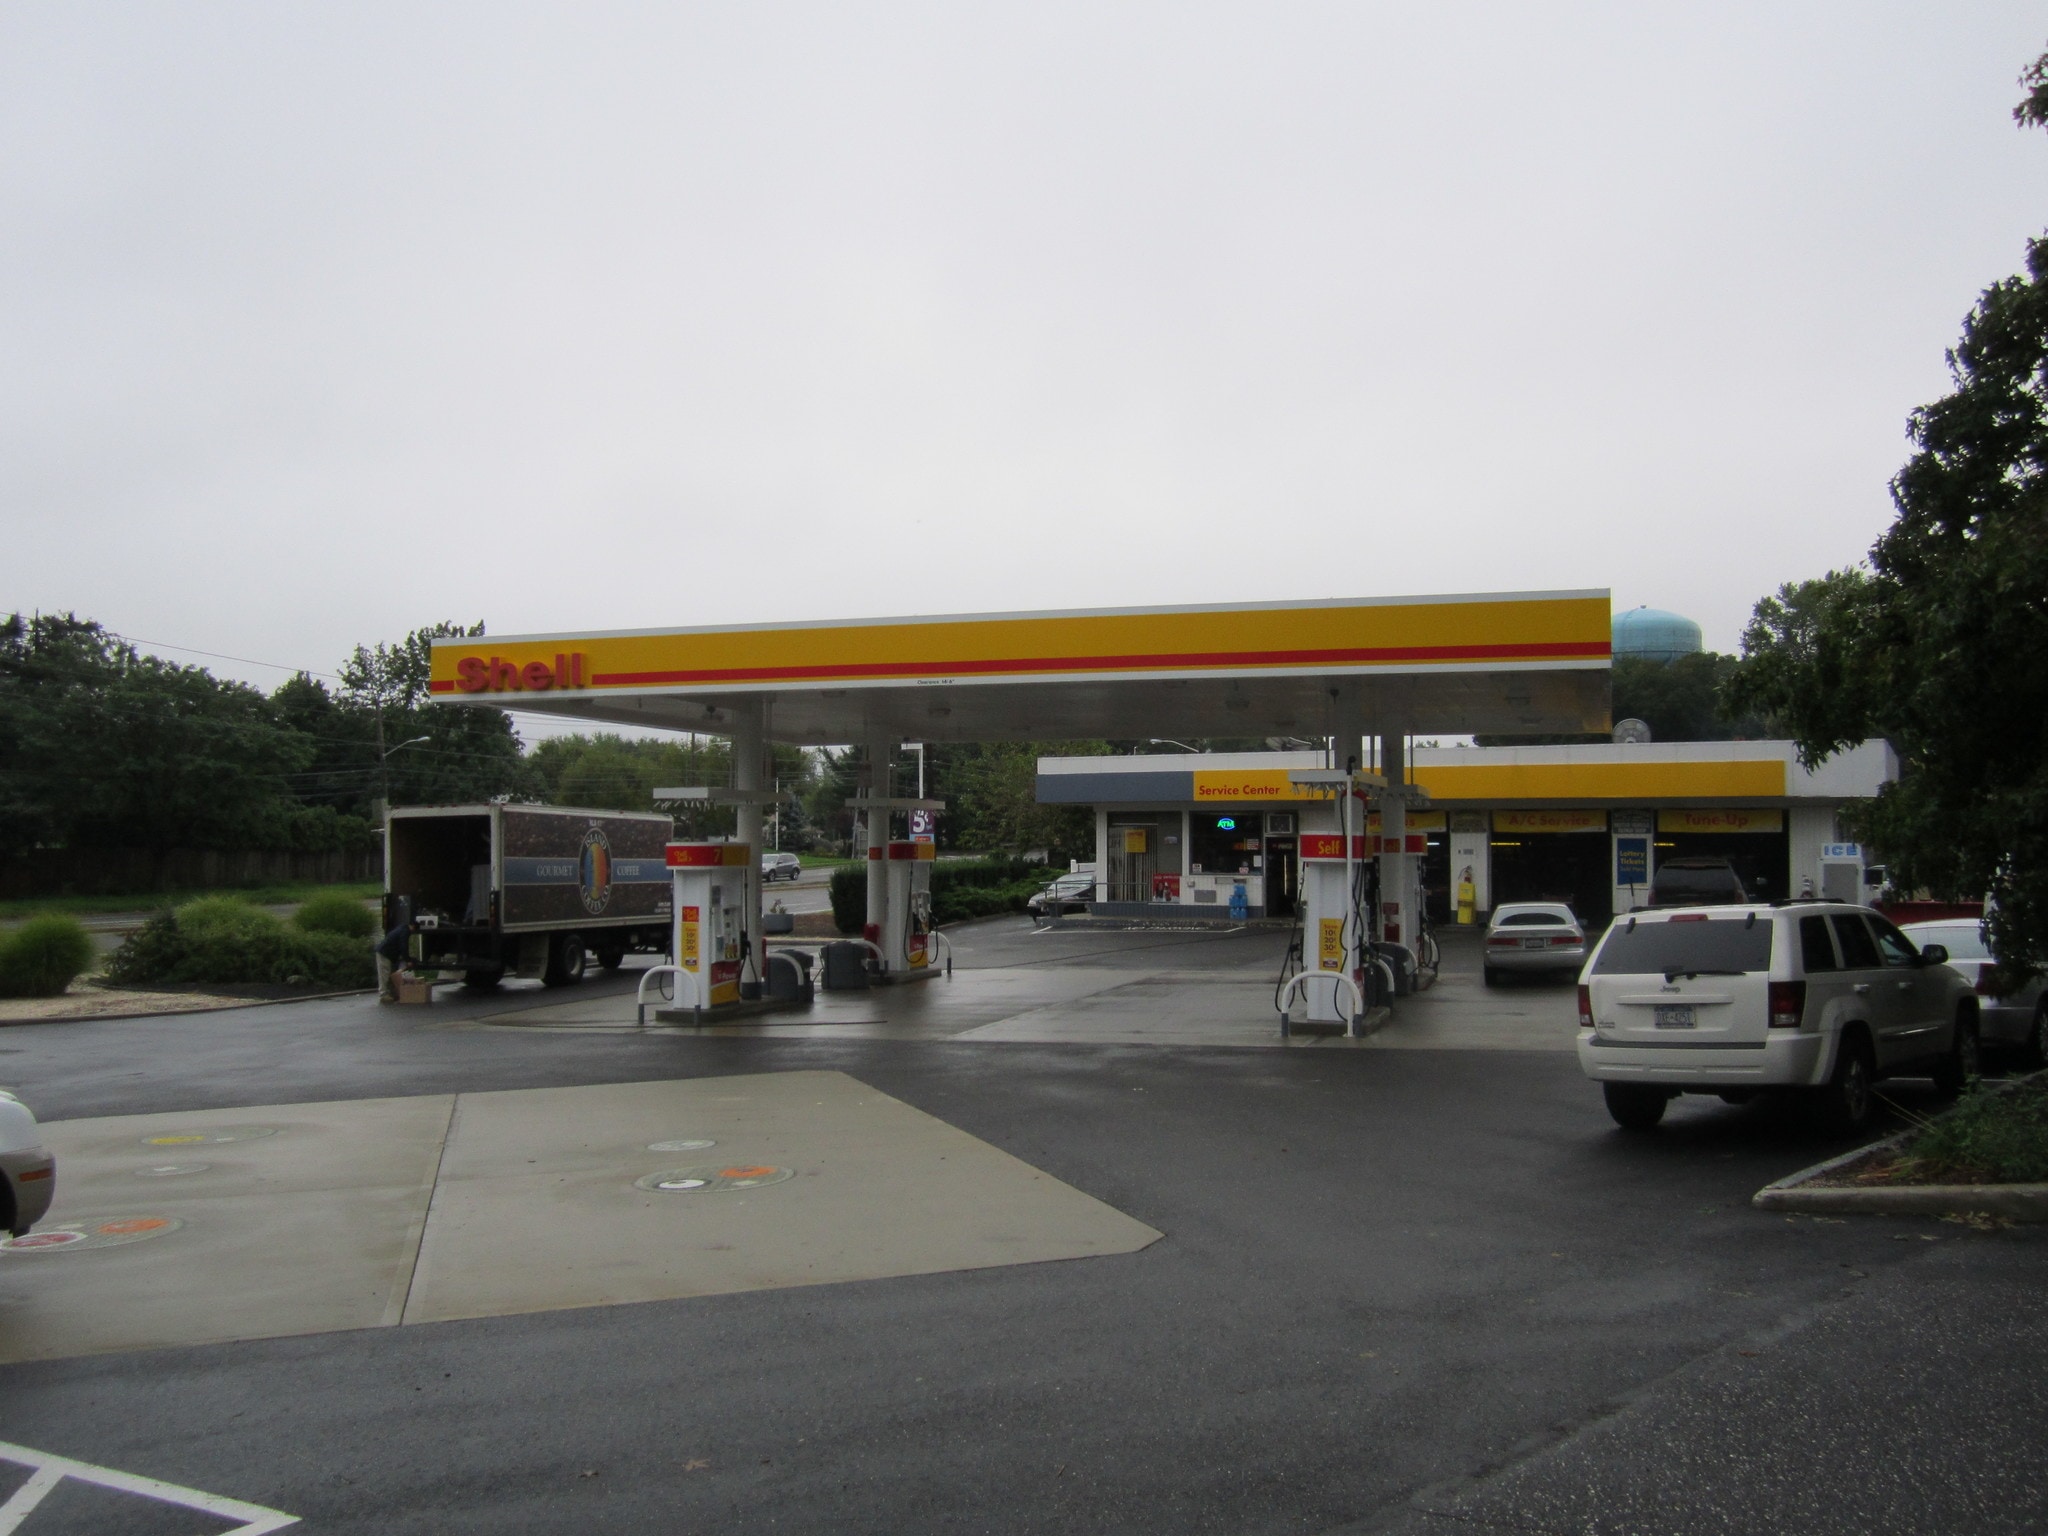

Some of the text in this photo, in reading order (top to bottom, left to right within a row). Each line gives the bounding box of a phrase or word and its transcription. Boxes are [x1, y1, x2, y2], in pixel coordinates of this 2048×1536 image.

[456, 652, 582, 692] Shell
[1198, 784, 1281, 796] Service Center
[1216, 819, 1236, 828] ATM
[1508, 814, 1591, 826] A/C Service
[1684, 813, 1749, 828] Tune-Up
[1318, 840, 1341, 855] Self
[1823, 844, 1858, 857] ICE
[1619, 850, 1645, 858] Lottery
[1619, 857, 1645, 865] Tickets
[536, 864, 574, 877] GOURMET
[616, 864, 641, 876] COFFEE
[1659, 985, 1682, 994] Jeep
